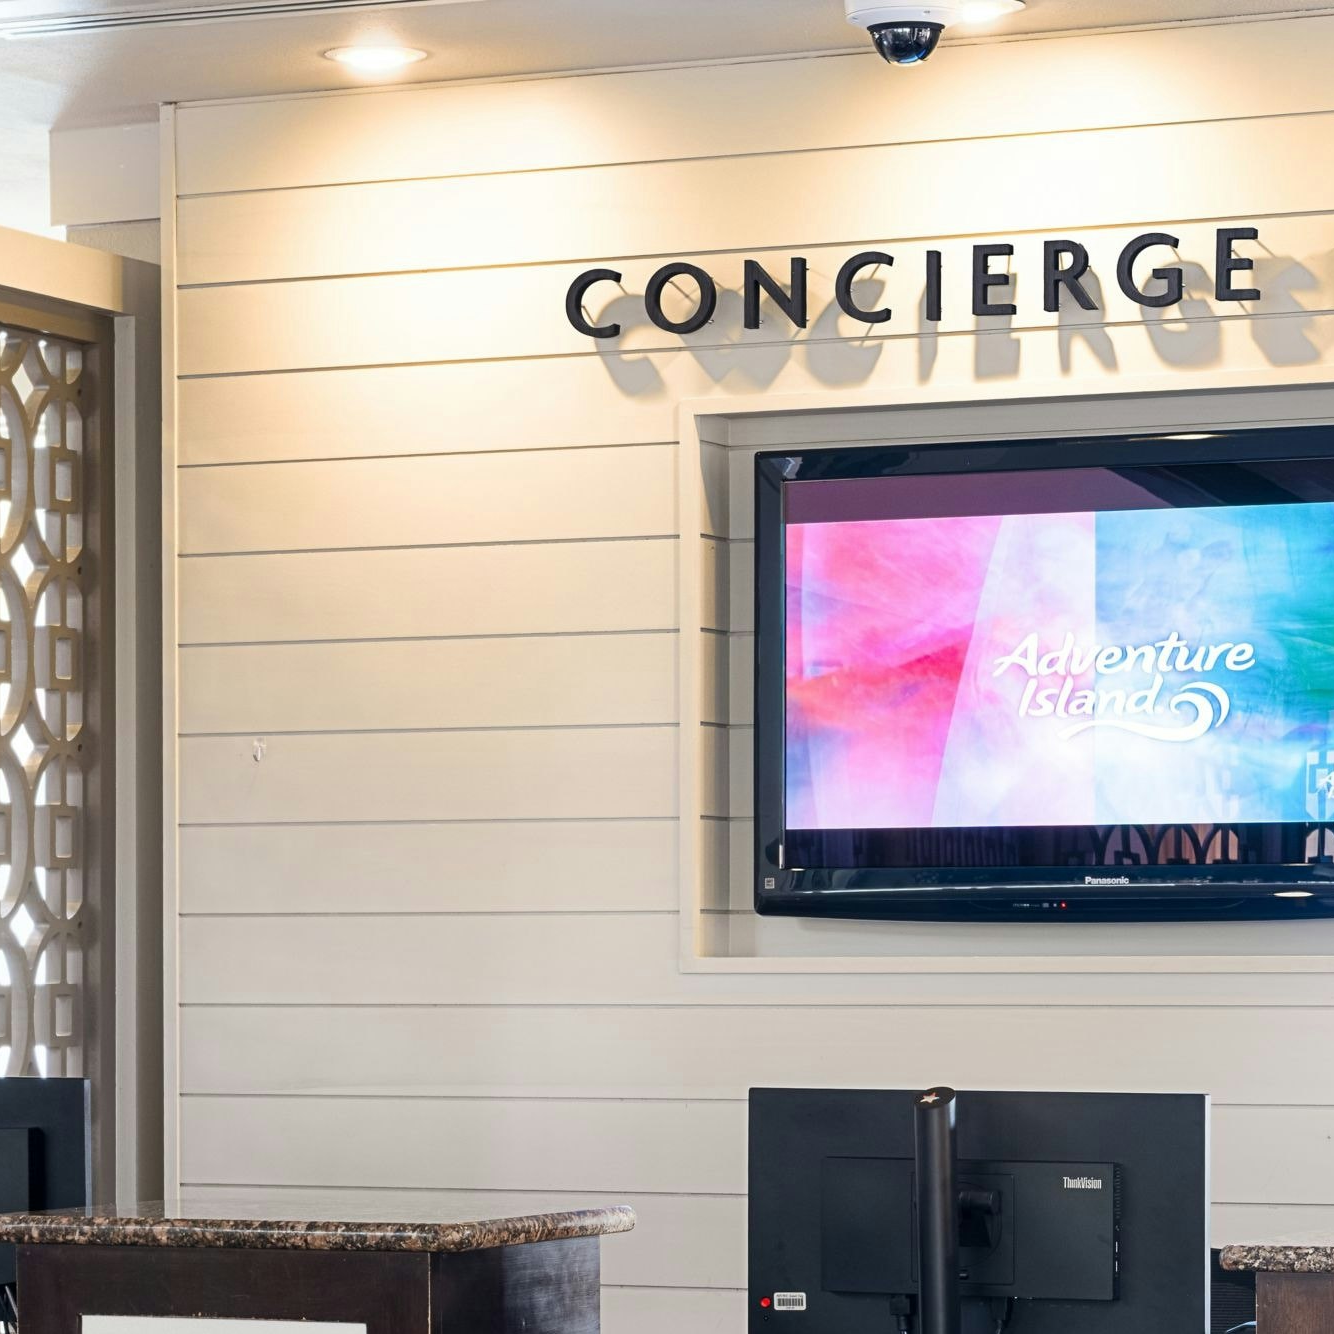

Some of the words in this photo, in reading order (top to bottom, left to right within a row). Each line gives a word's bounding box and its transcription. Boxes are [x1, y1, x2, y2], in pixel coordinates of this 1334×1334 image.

[564, 227, 1261, 339] CONCIERGE
[992, 631, 1256, 678] Adventure
[1018, 673, 1164, 719] Island
[1085, 876, 1130, 885] Panasonic
[1062, 1176, 1102, 1189] ThinkVision
